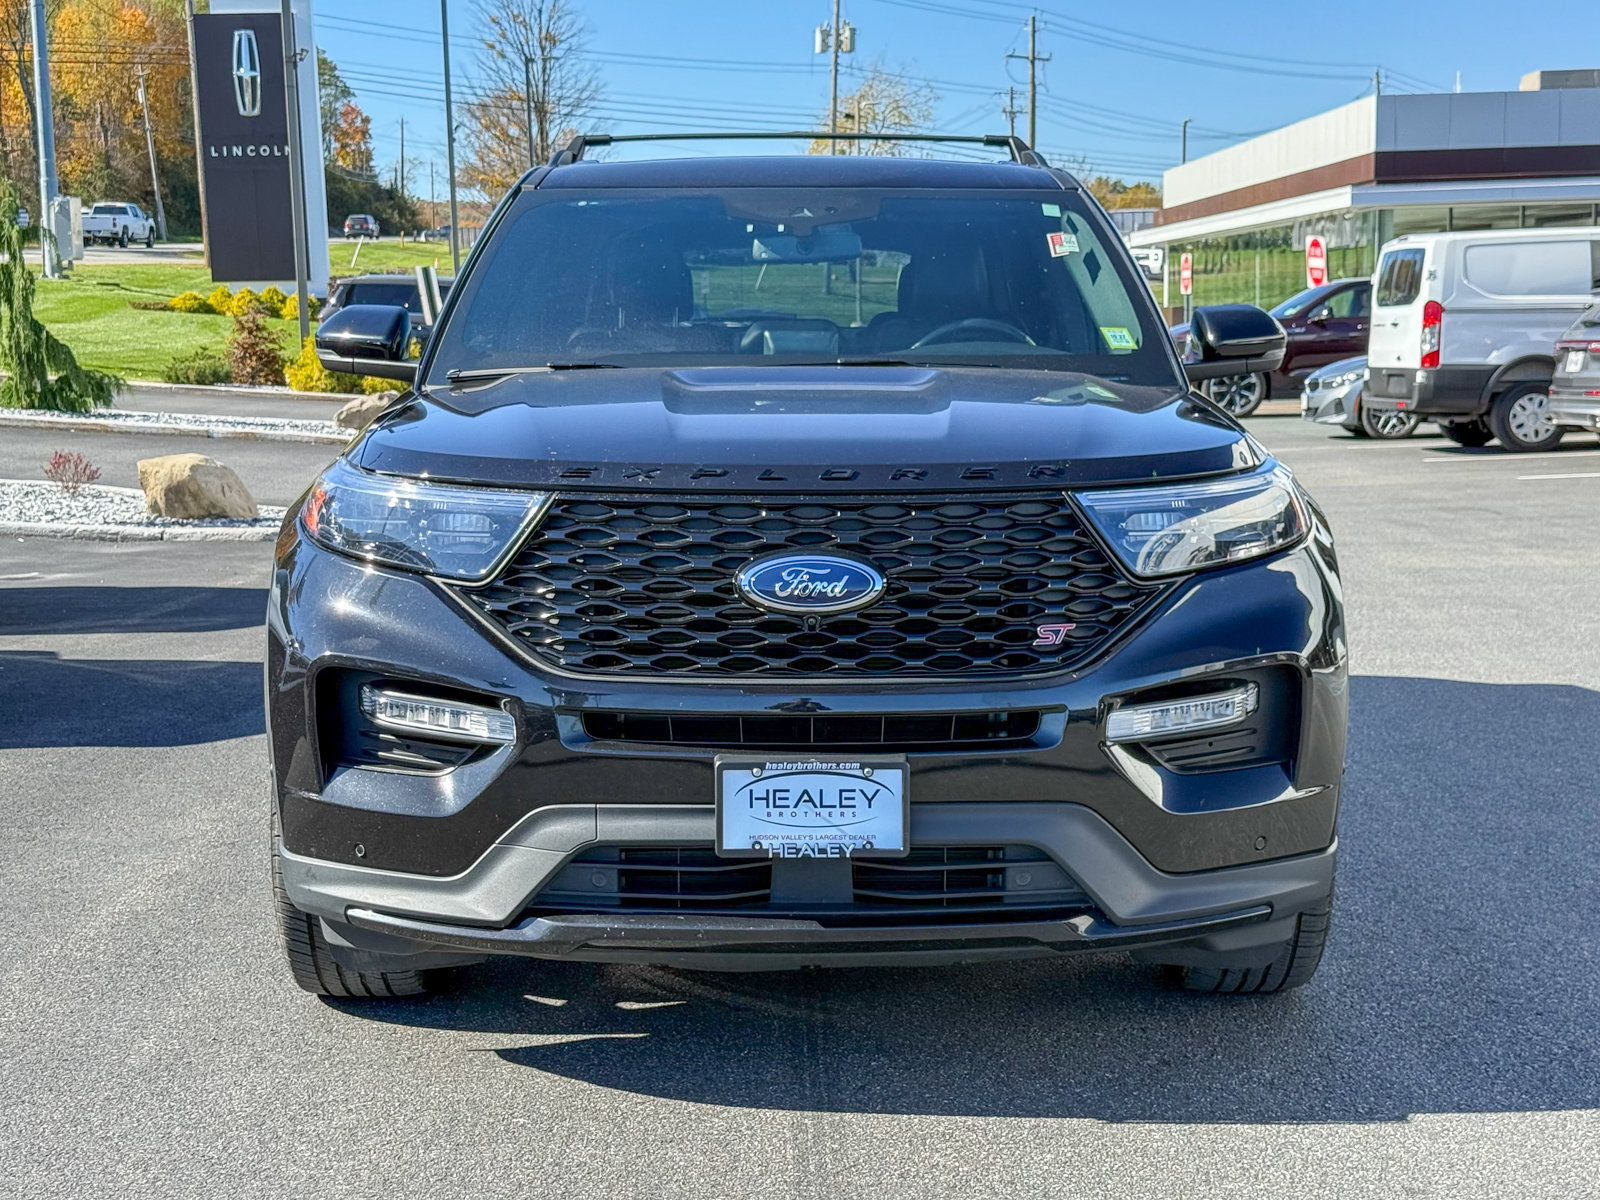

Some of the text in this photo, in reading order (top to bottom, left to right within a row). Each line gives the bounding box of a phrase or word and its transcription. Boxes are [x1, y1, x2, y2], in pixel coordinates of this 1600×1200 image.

[558, 464, 1065, 481] EXPLORER
[774, 567, 849, 597] Ford
[1032, 623, 1077, 646] ST
[765, 761, 861, 770] healeybrothers.com
[749, 788, 881, 809] HEALEY
[767, 842, 857, 859] HEALEY
